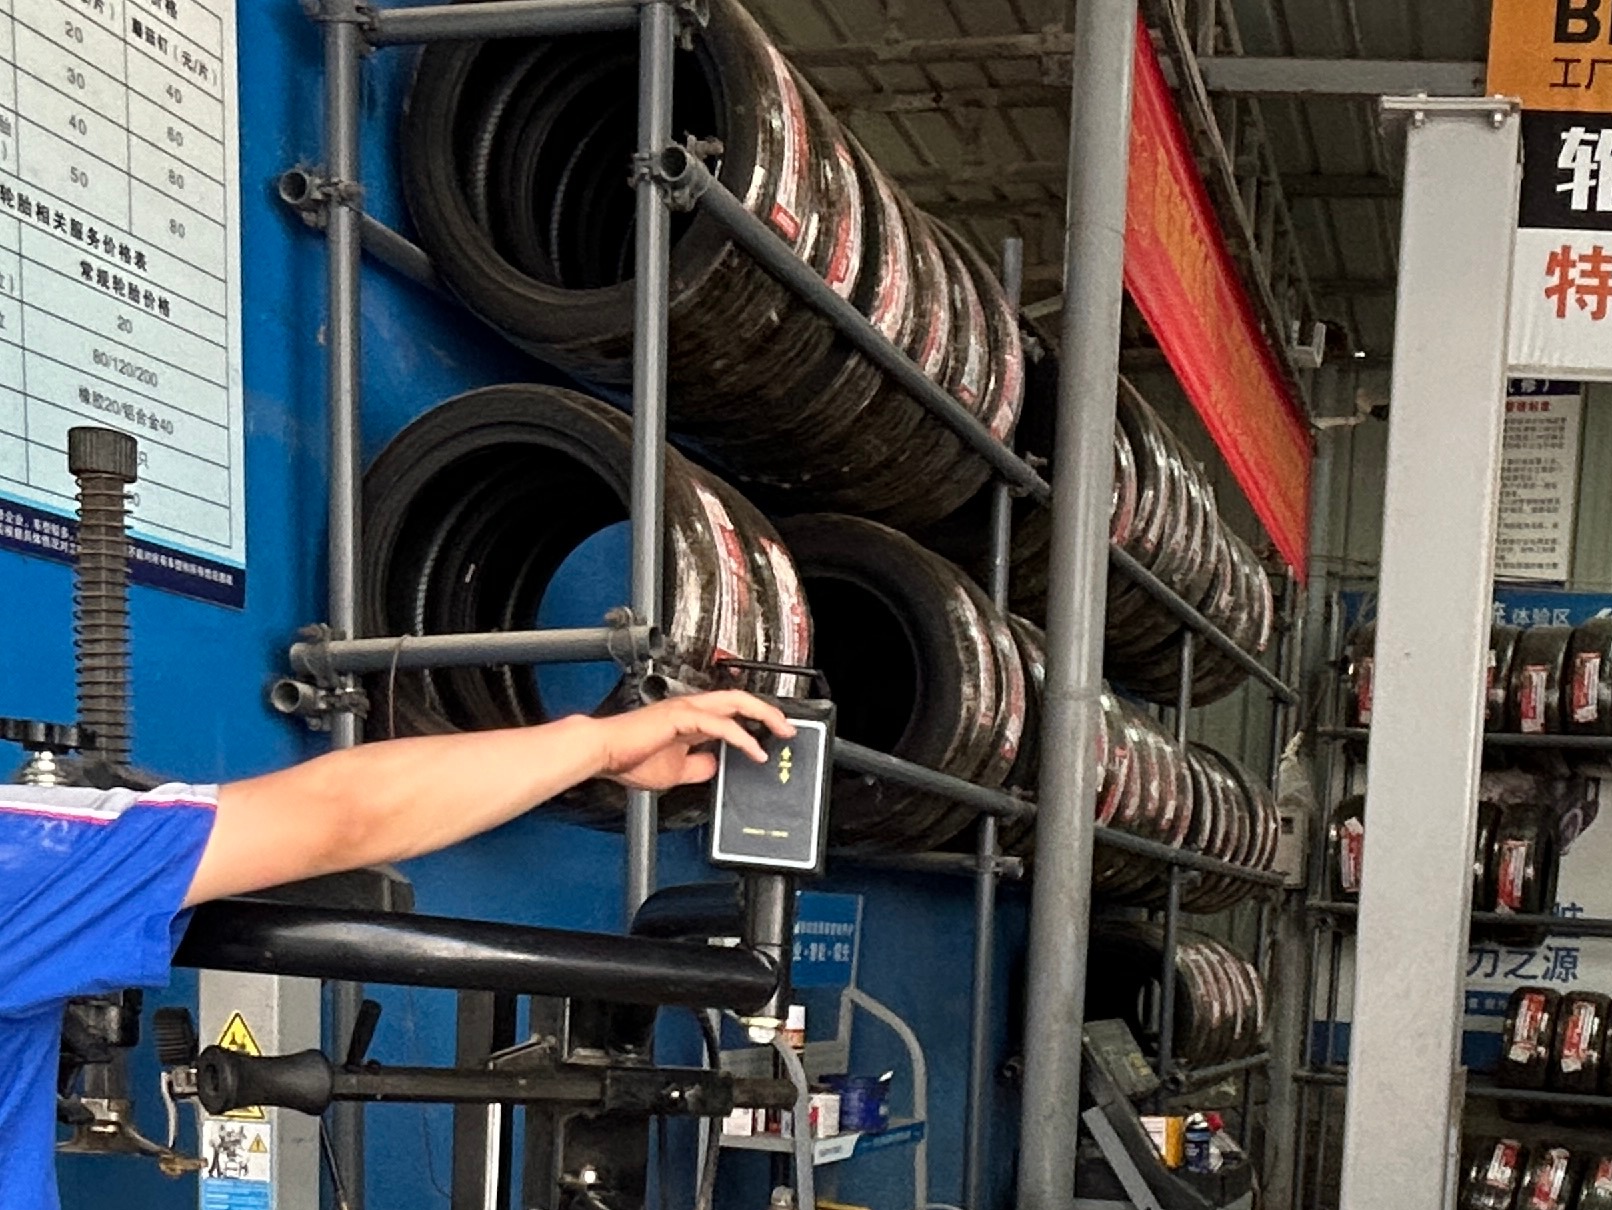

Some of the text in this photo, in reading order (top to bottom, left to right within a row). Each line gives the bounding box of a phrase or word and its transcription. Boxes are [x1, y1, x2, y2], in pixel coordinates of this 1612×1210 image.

[64, 20, 84, 44] 20
[66, 66, 86, 90] 30
[165, 84, 183, 104] 40
[68, 114, 88, 136] 40
[70, 166, 89, 188] 50
[116, 315, 133, 334] 20
